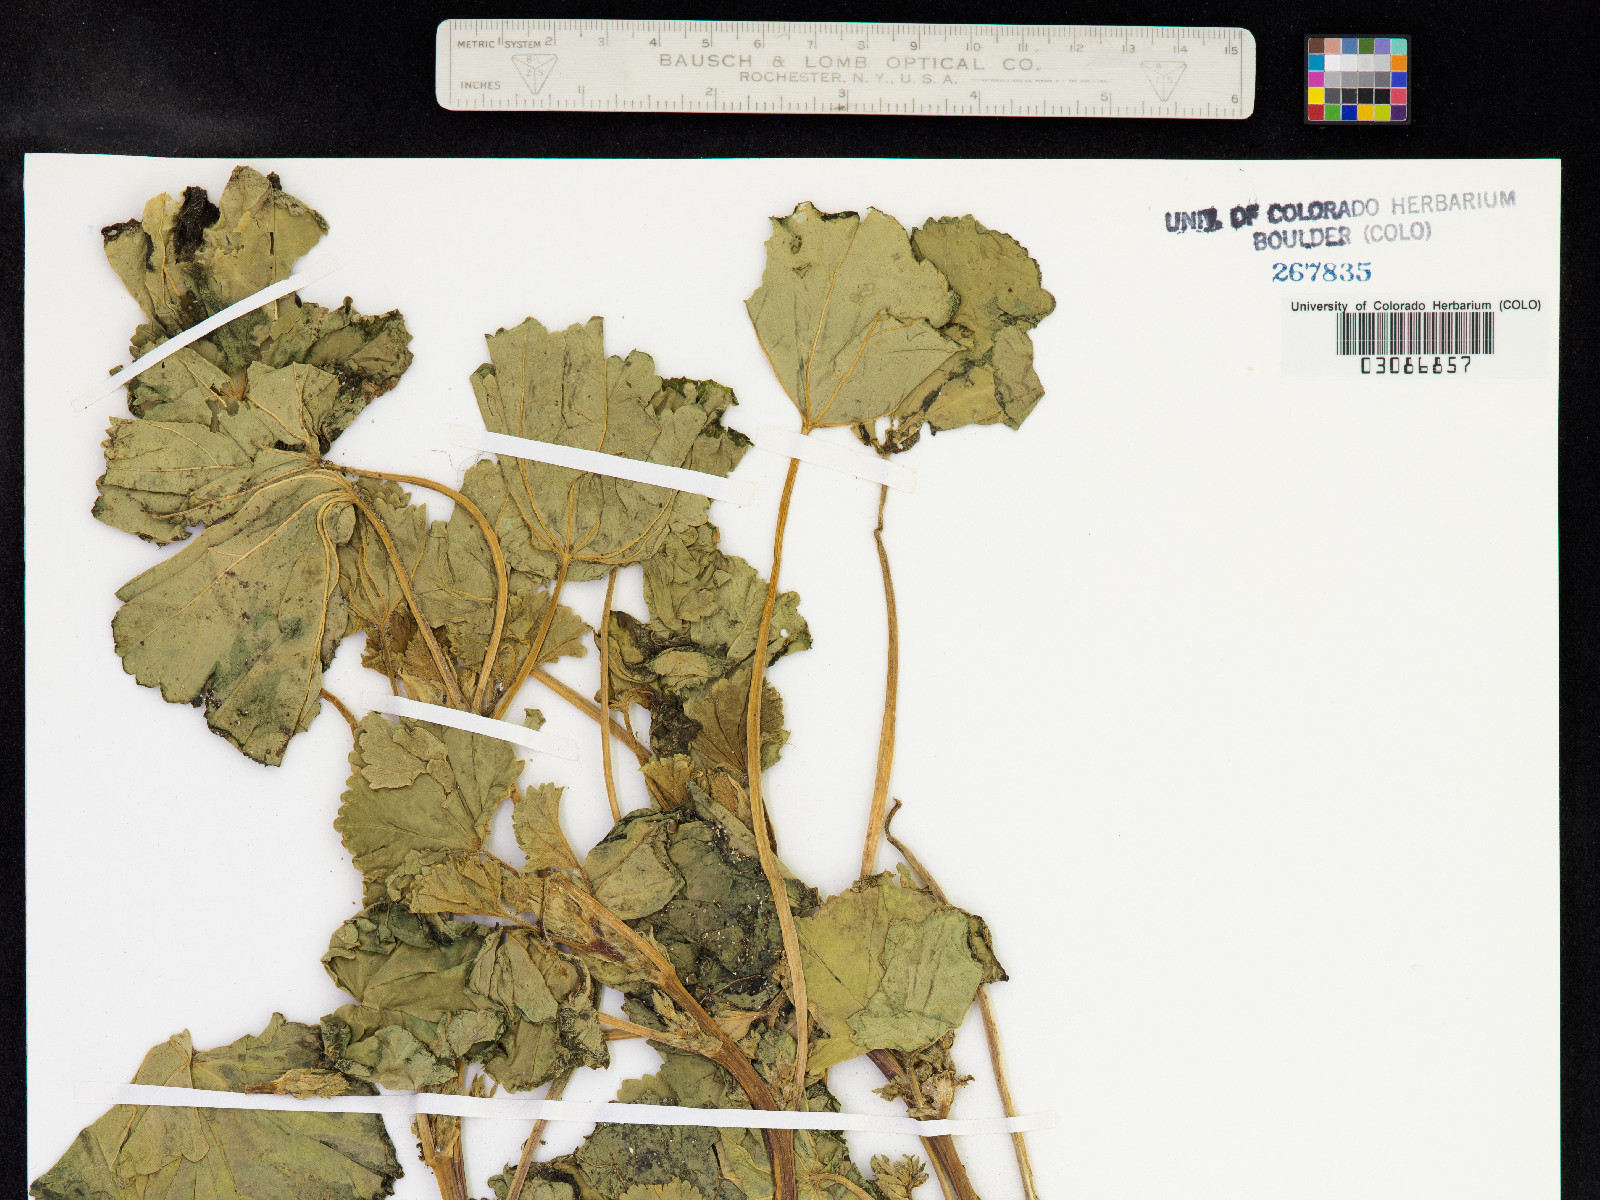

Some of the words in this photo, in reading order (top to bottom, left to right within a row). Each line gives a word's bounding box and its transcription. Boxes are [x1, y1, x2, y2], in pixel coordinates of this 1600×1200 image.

[457, 40, 496, 49] METRIC
[504, 40, 541, 49] SYSTEM
[659, 53, 753, 68] BAUSCH
[772, 55, 785, 68] &
[805, 56, 868, 70] LOMB
[886, 56, 985, 72] OPTICAL
[1002, 57, 1041, 72] CO.
[739, 71, 847, 83] ROCHESTER,
[460, 81, 501, 90] INCHES
[1230, 203, 1259, 229] OF
[1266, 198, 1380, 225] COLORADO
[1391, 190, 1516, 215] HERBARIUM
[1253, 226, 1351, 251] BOULDER
[1363, 221, 1432, 243] (COLO)
[1272, 262, 1372, 283] 267835
[1290, 300, 1349, 313] University
[1355, 300, 1368, 311] of
[1373, 300, 1426, 311] Colorado
[1432, 300, 1492, 311] Herbarium
[1499, 299, 1542, 312] (COLO)
